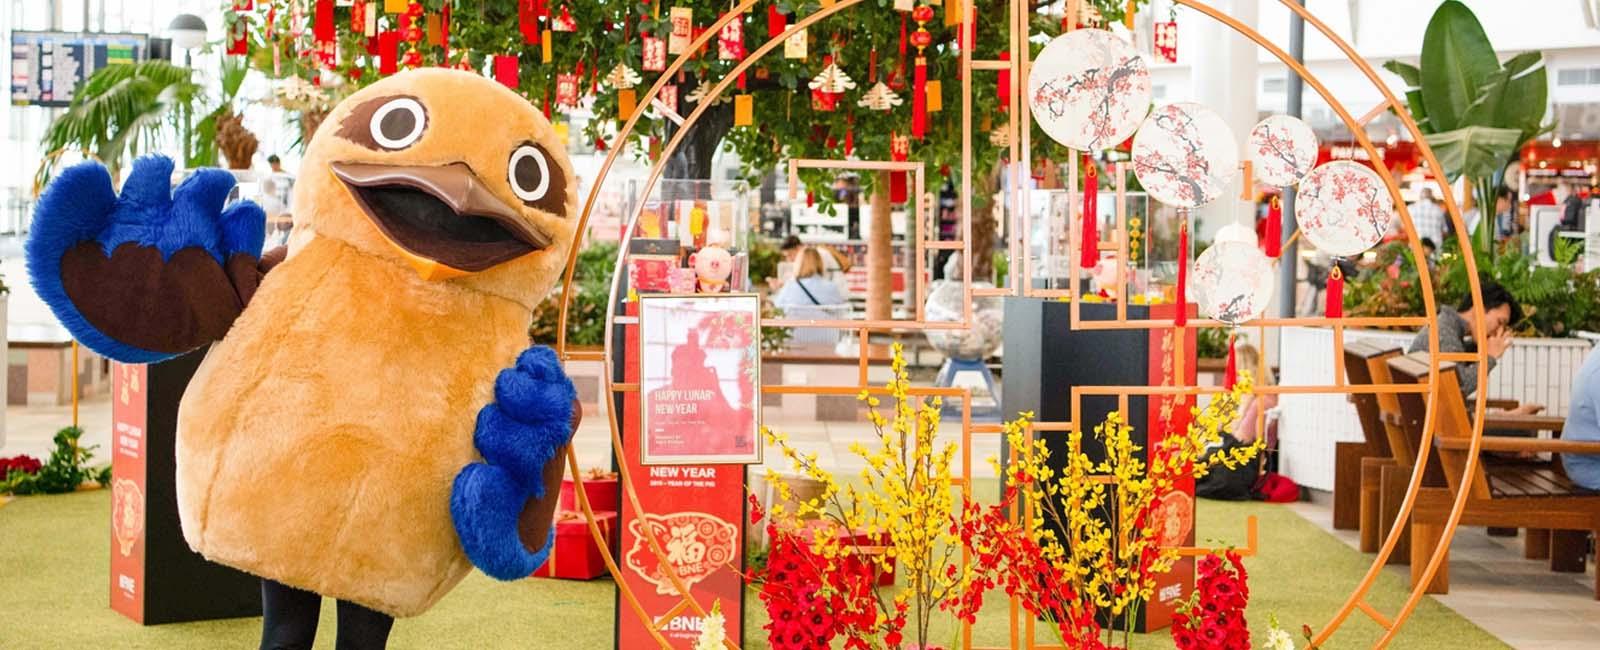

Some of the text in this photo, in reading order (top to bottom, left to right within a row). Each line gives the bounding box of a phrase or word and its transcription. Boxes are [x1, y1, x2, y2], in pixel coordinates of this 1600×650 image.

[655, 389, 713, 401] HAPPY LUNAR
[655, 403, 698, 415] NEW YEAR
[650, 466, 716, 479] NEW YEAR
[666, 523, 705, 565] 福
[679, 562, 704, 576] BNE
